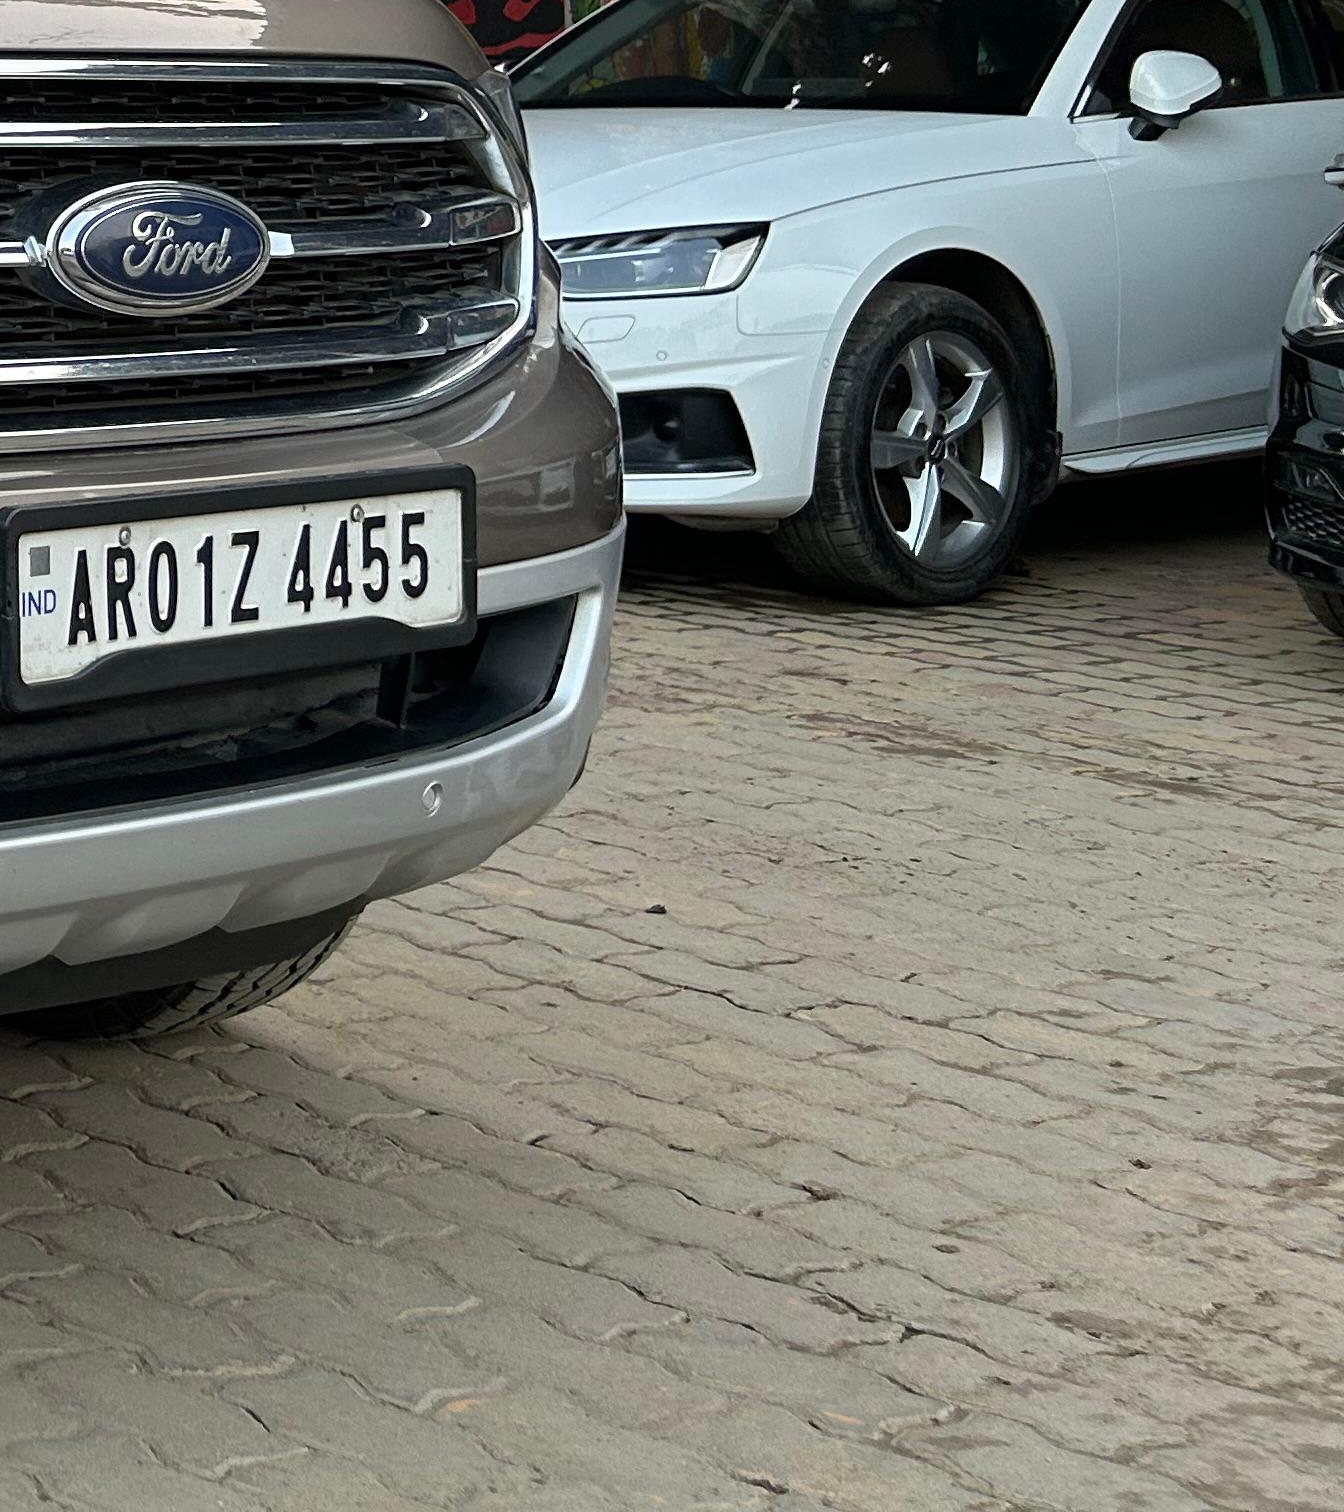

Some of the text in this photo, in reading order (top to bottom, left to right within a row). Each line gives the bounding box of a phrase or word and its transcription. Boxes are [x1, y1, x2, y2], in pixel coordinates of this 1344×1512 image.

[122, 211, 232, 277] Ford
[286, 512, 429, 613] 4455
[21, 589, 57, 617] IND
